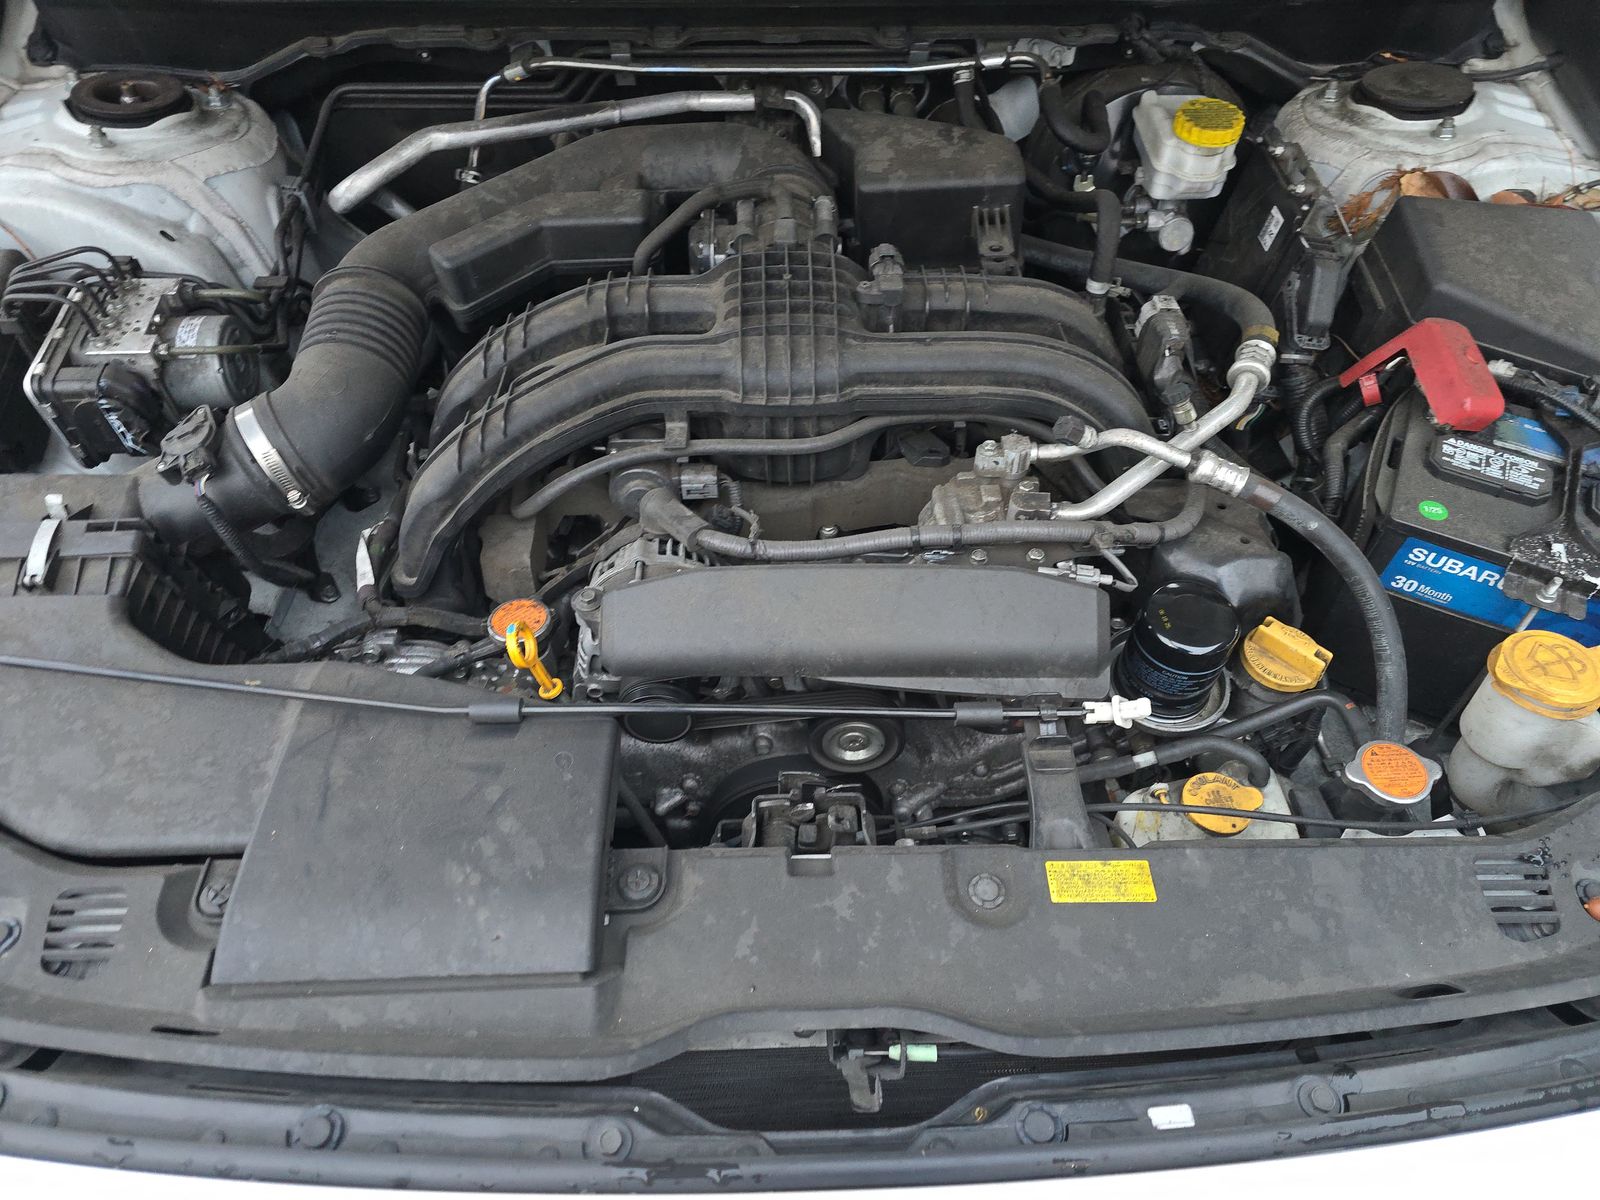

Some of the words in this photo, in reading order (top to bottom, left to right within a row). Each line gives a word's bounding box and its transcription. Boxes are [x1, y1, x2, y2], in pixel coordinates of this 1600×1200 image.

[1457, 440, 1495, 455] DANGER
[1503, 453, 1538, 468] POISON
[1390, 575, 1419, 592] 30
[1418, 584, 1453, 602] Month
[1161, 670, 1188, 680] CAUTION
[1187, 775, 1240, 796] COOLANT
